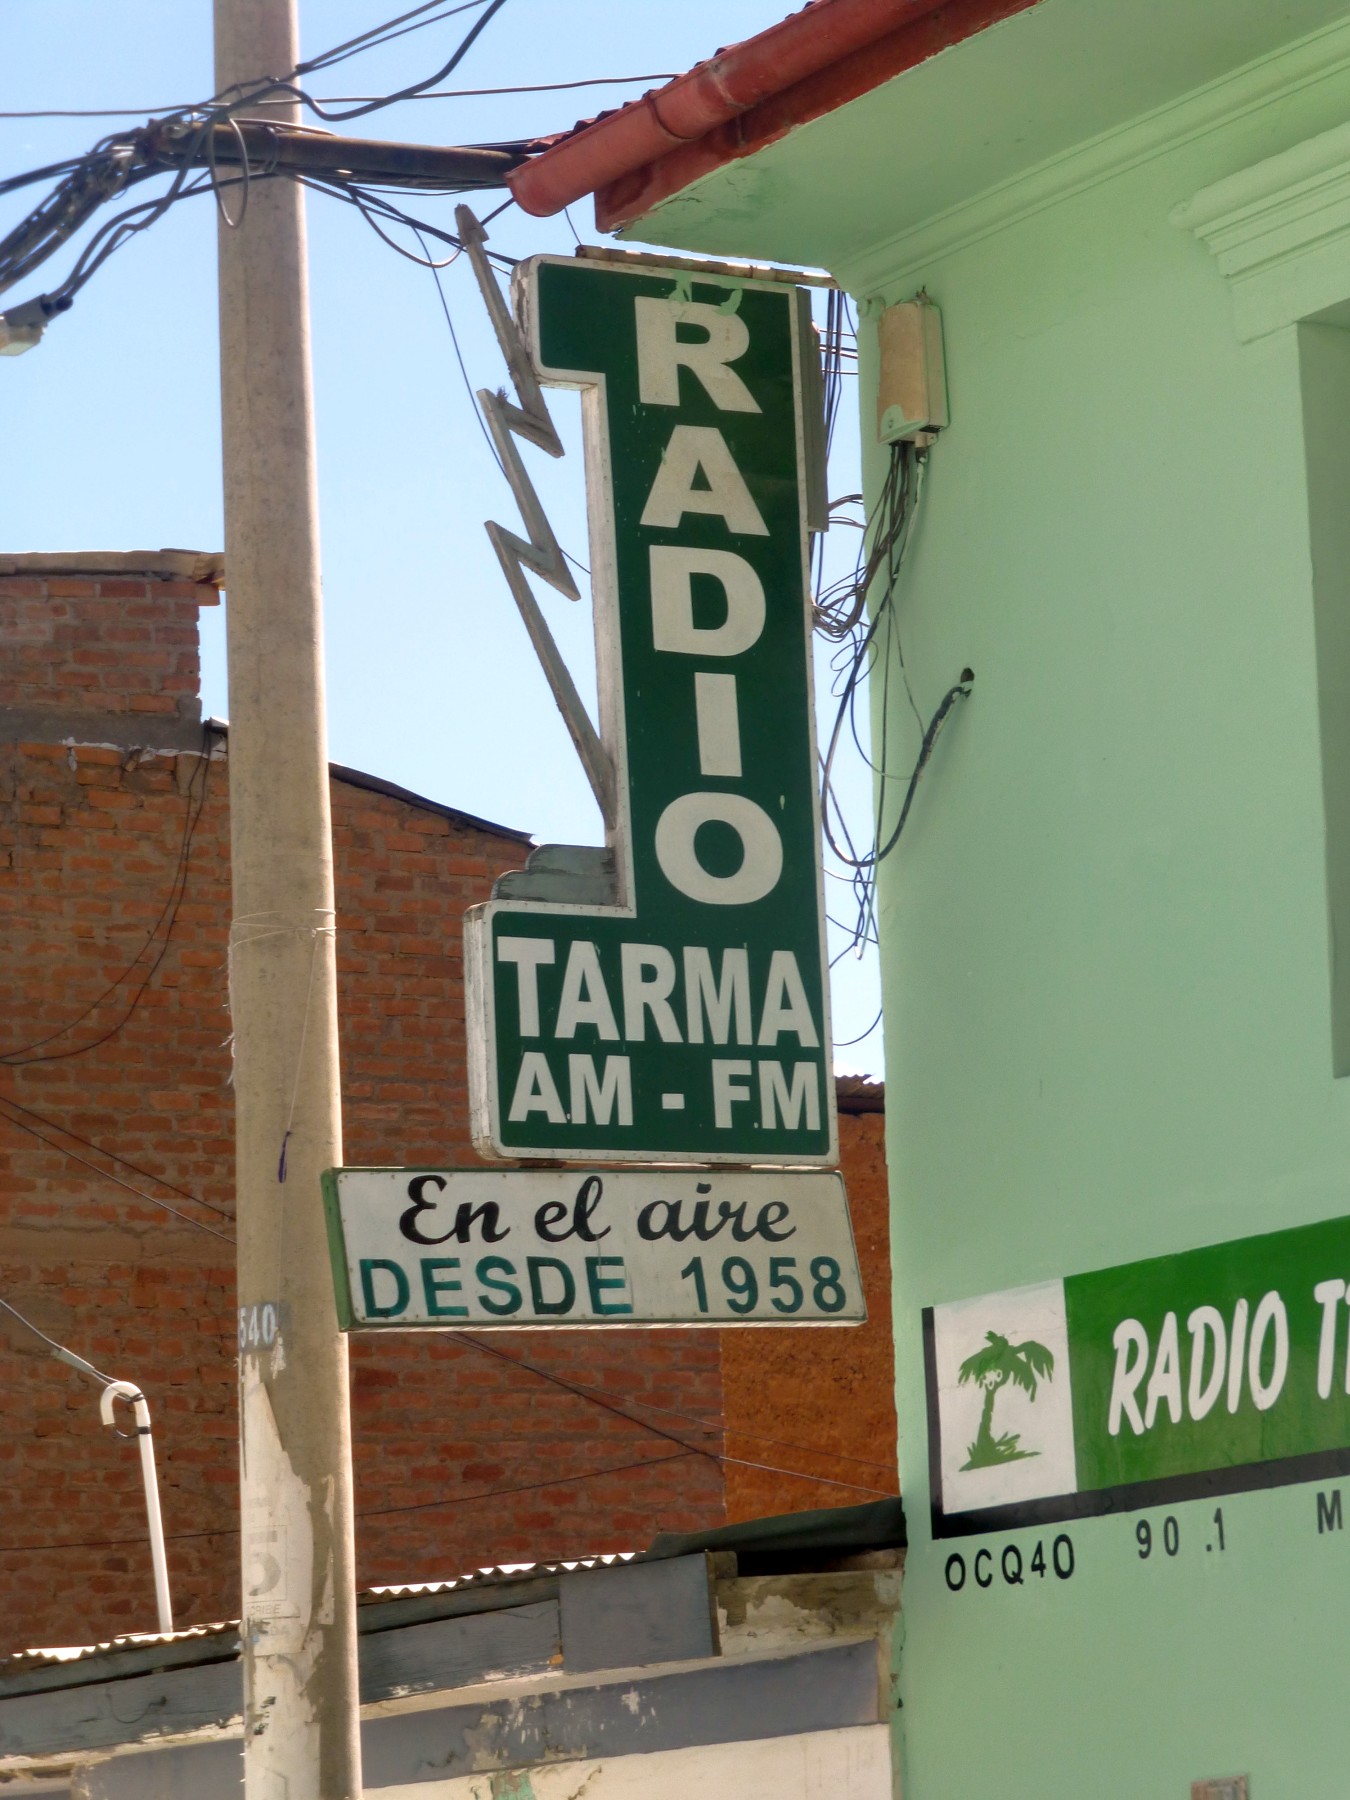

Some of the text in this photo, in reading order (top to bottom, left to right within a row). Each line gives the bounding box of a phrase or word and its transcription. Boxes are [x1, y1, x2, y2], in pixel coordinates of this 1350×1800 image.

[636, 296, 784, 904] RADIO
[497, 936, 820, 1048] TARMA
[507, 1051, 821, 1131] AM - FM
[399, 1174, 797, 1245] En el aire
[359, 1255, 846, 1318] DESDE 1958
[1109, 1278, 1350, 1436] RADIO T
